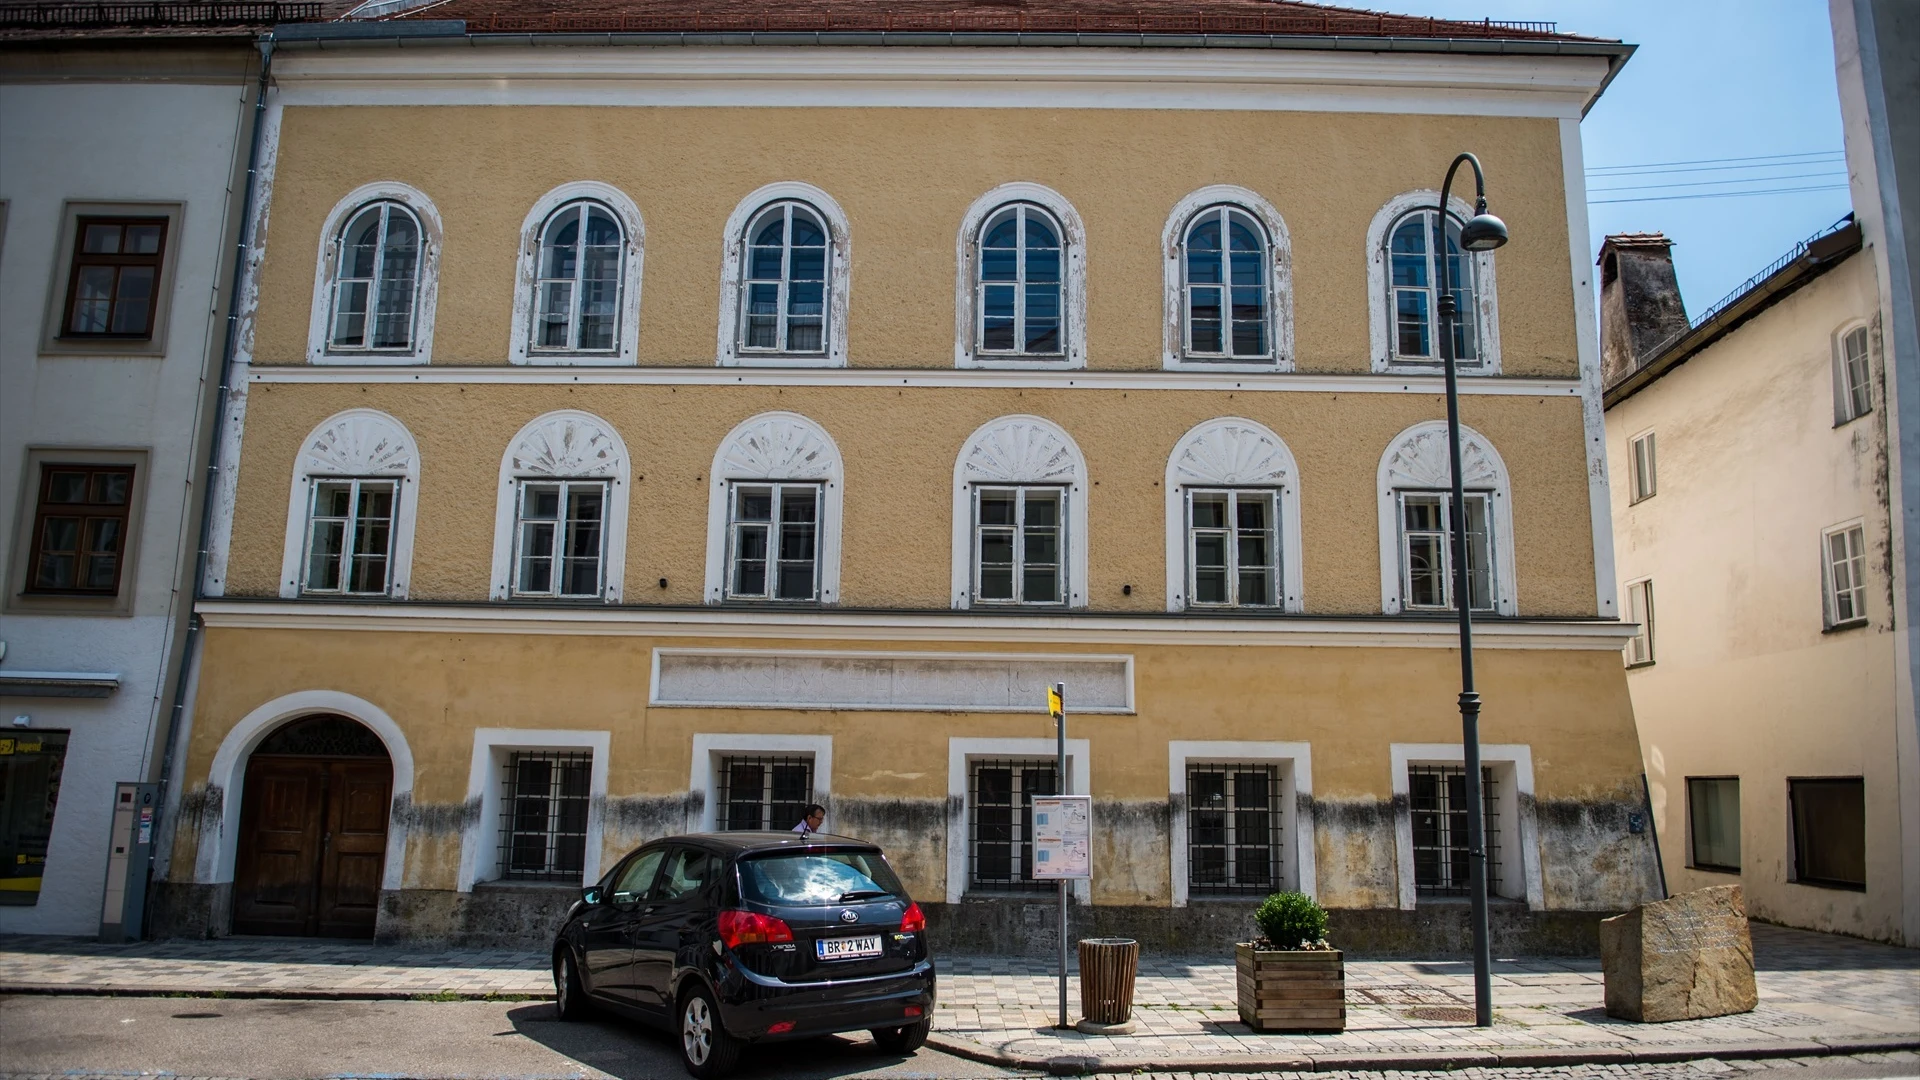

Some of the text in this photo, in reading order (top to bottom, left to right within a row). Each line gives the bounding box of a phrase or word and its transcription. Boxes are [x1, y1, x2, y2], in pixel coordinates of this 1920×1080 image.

[827, 938, 875, 953] BR 2 WAV
